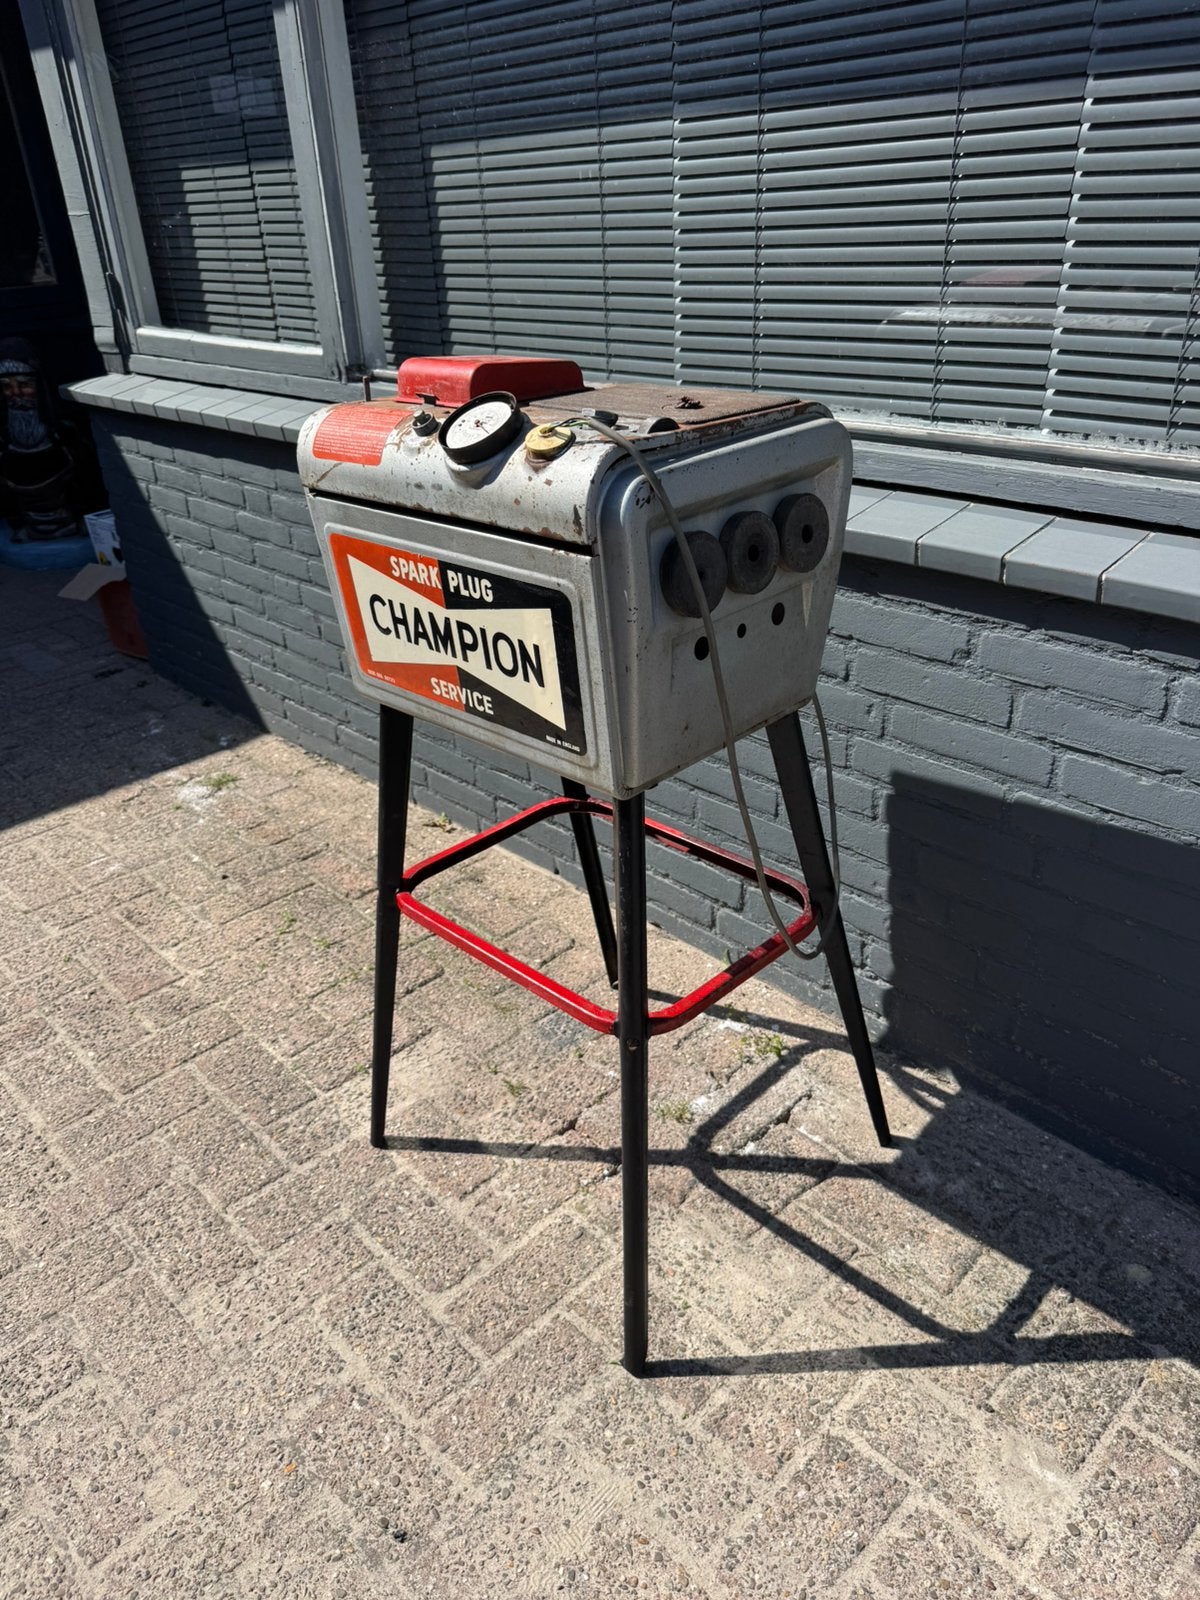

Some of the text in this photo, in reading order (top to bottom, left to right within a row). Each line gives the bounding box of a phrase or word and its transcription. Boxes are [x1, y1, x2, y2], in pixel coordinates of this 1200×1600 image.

[389, 555, 494, 603] SPARK PLUG
[369, 593, 545, 688] CHAMPION
[430, 677, 494, 715] SERVICE
